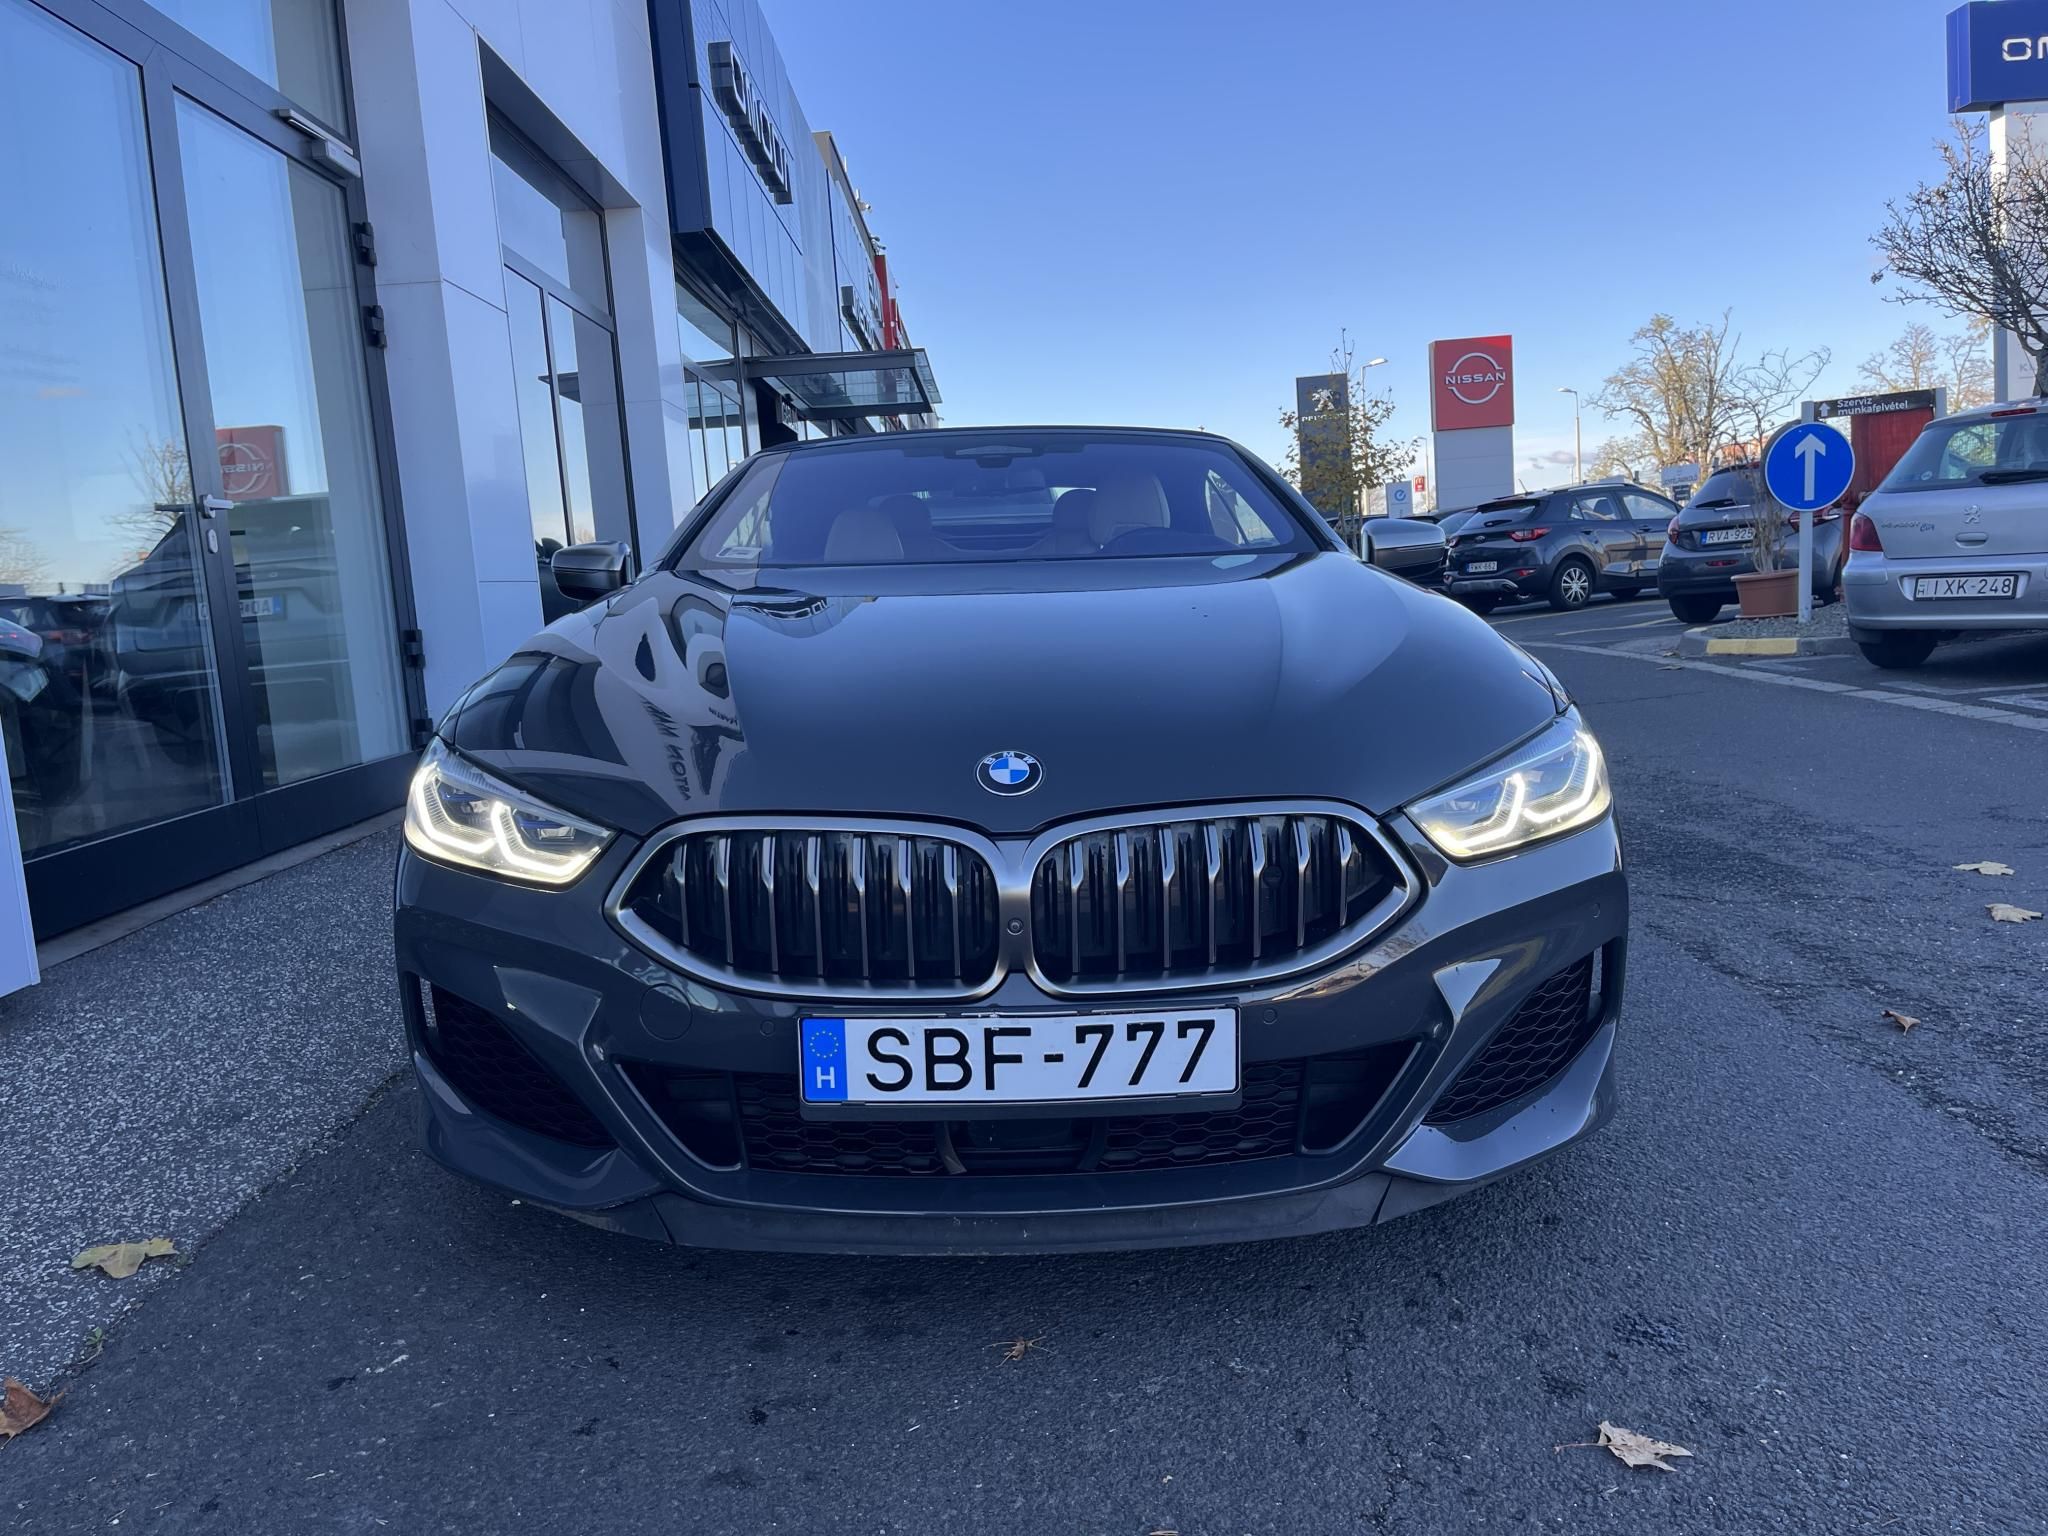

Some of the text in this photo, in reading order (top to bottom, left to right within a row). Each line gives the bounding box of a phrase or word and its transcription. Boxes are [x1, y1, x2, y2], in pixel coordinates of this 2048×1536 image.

[1445, 371, 1506, 385] NISSAN
[1837, 396, 1873, 408] Szerviz
[1837, 400, 1908, 416] munkafelvétel
[1708, 528, 1754, 542] RVA-925
[1934, 578, 2012, 595] IXK-248
[983, 752, 1037, 764] BMW
[866, 1020, 1216, 1092] SBF-777
[816, 1066, 836, 1089] H
